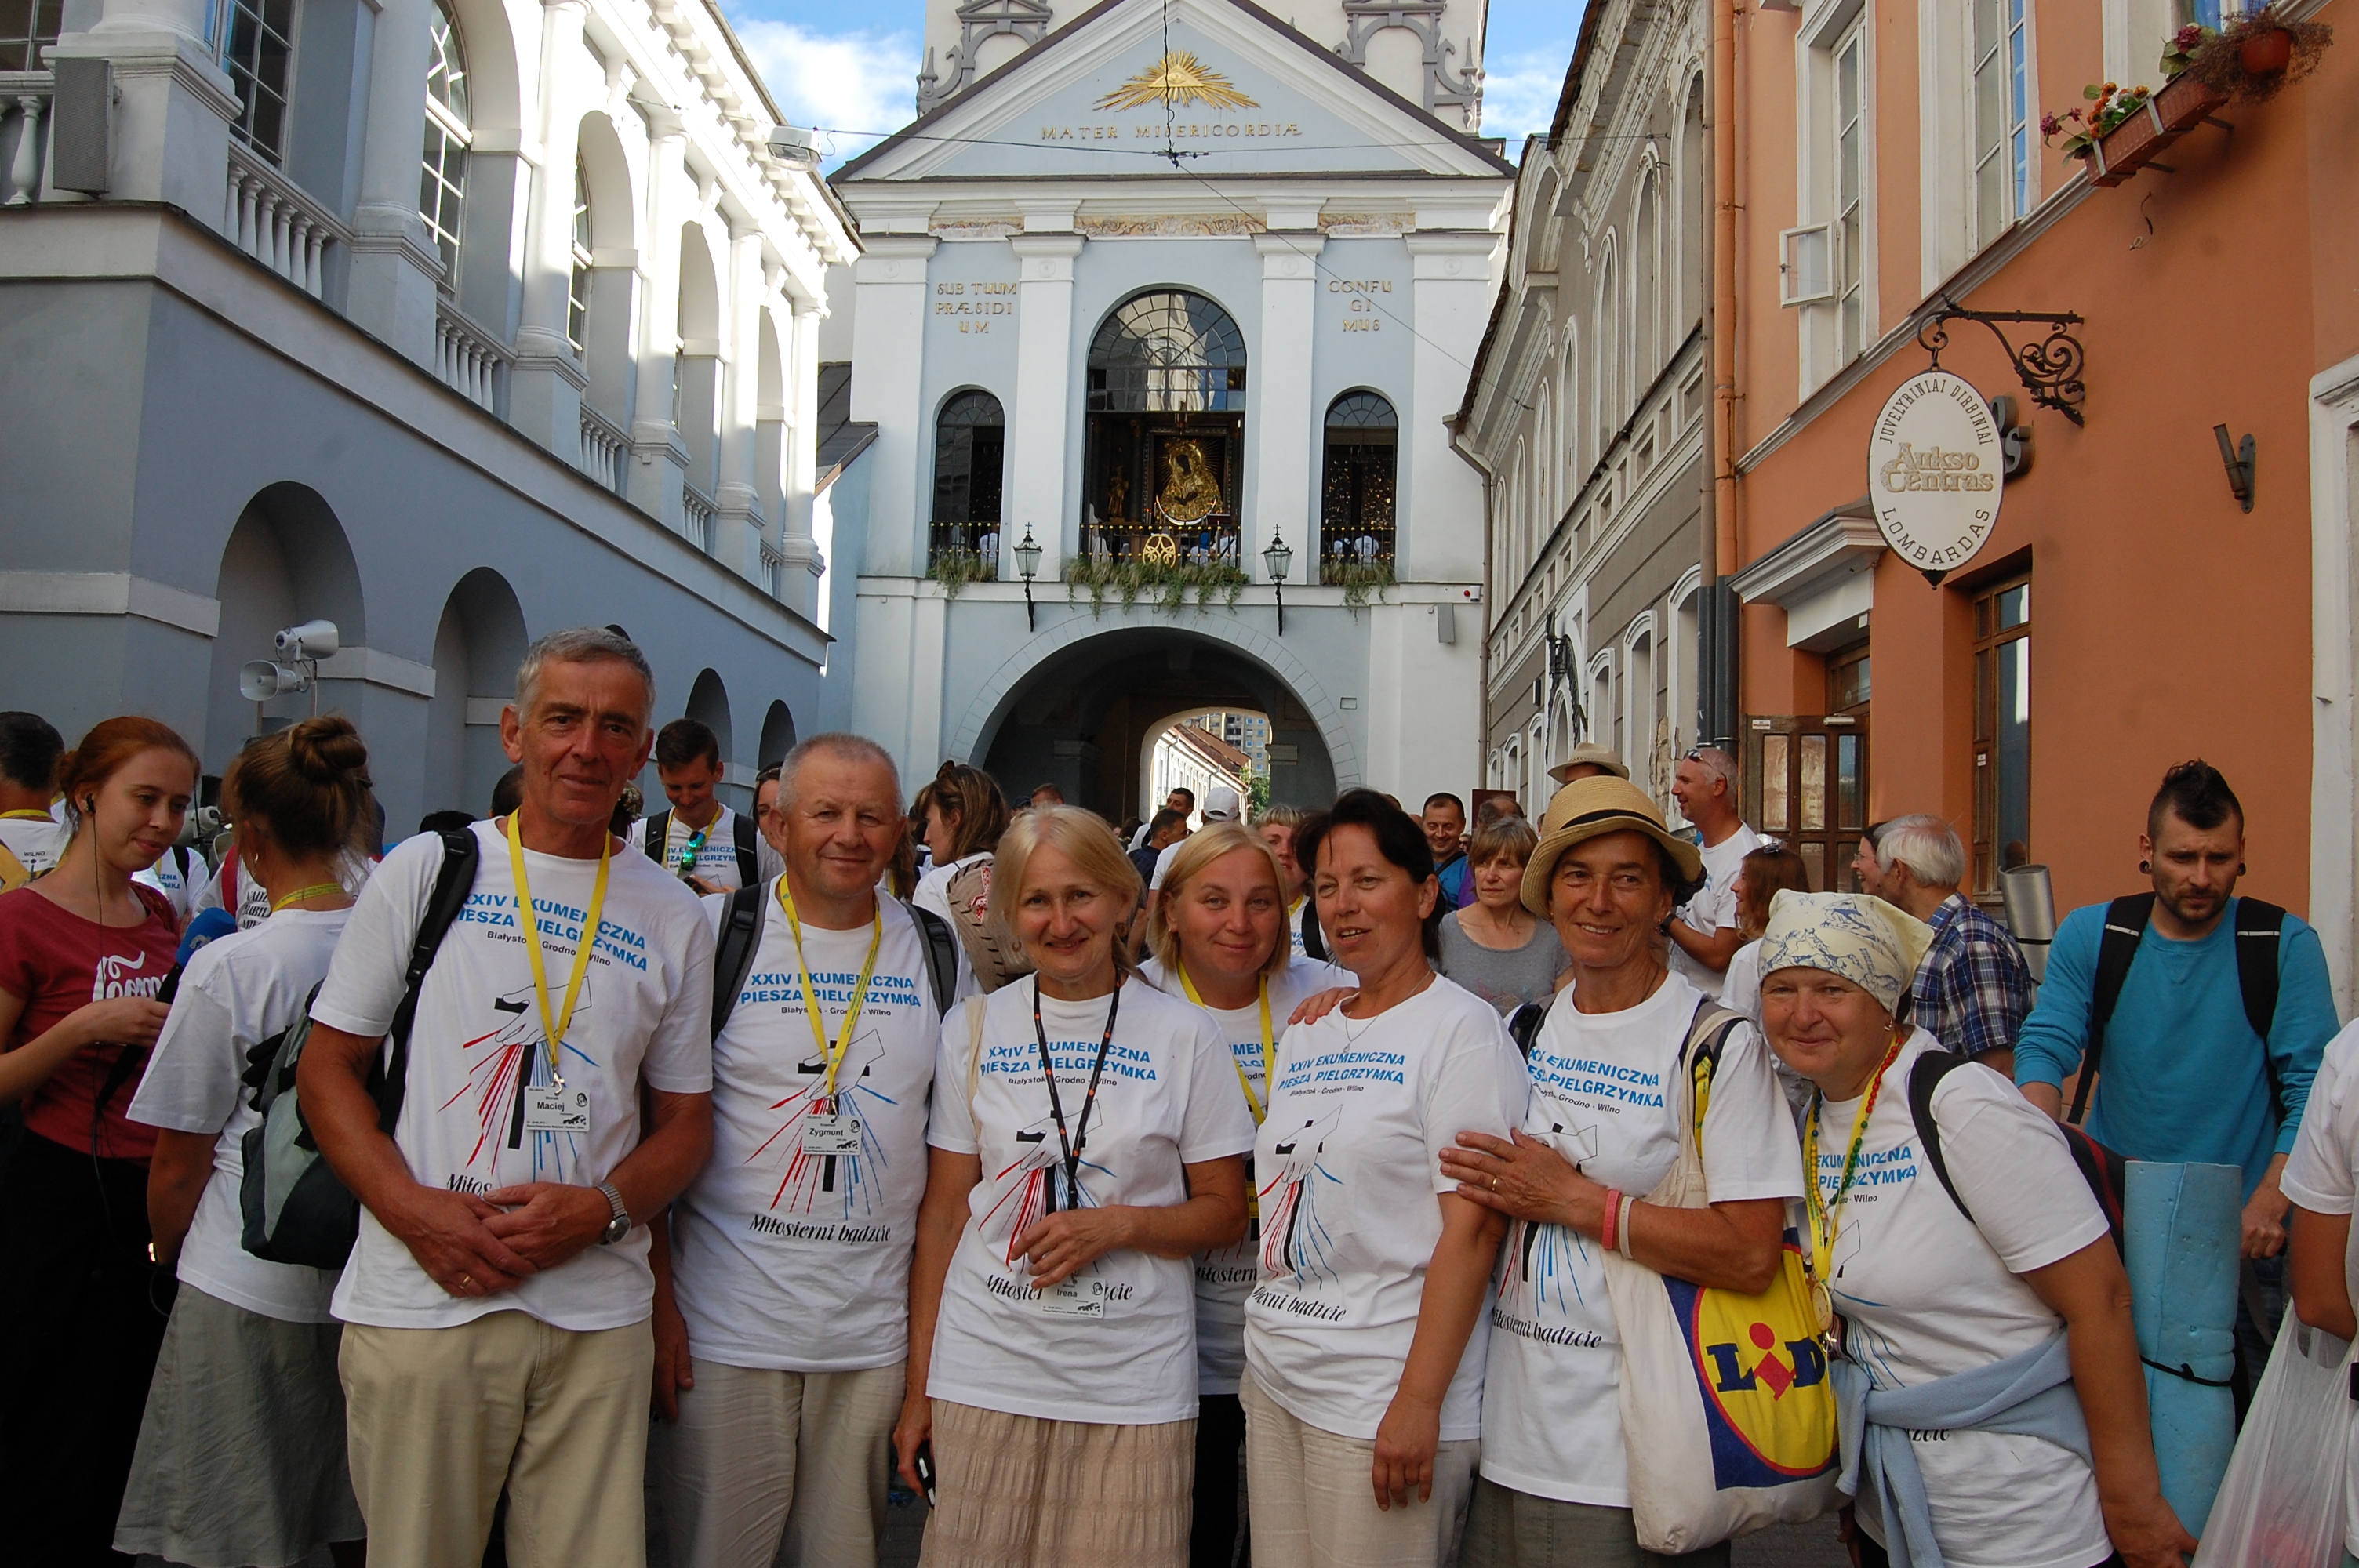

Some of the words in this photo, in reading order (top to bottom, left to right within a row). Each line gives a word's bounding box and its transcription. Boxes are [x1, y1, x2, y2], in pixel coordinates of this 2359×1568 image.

[1041, 126, 1118, 140] MATER
[937, 283, 964, 296] SUB
[971, 282, 1017, 296] TUUM
[1328, 281, 1392, 293] CONFU
[1350, 299, 1372, 312] GI
[1343, 319, 1380, 332] MUS
[1880, 379, 1946, 445] JUVELYRINIAI
[1950, 384, 1994, 445] DIRBINIAI
[1891, 442, 1979, 471] Aukso
[1880, 459, 1994, 493] Centras
[1882, 507, 1990, 564] LOMBARDAS
[458, 908, 514, 927] IESZA
[535, 918, 647, 971] IELGZYMKA
[487, 931, 527, 944] Białysto
[542, 941, 576, 956] Grodno
[751, 973, 792, 986] XXIV
[741, 989, 804, 1004] PIESZA
[781, 1007, 822, 1015] Białysk
[868, 1008, 892, 1017] Wilno
[988, 1045, 1024, 1058] XXIV
[1027, 1041, 1151, 1063] EUMENCZNA
[980, 1061, 1030, 1076] PIESZA
[1288, 1058, 1315, 1073] XXIV
[1315, 1052, 1405, 1065] EKUMENICZNA
[1546, 1054, 1659, 1087] EKUMENICZNA
[1055, 1076, 1085, 1084] Grodno
[1277, 1073, 1311, 1091] PIESZA
[1314, 1069, 1404, 1085] PIELGRZYMKA
[1547, 1073, 1664, 1109] PIELGRZYMKA
[536, 1101, 565, 1112] Maciej
[1558, 1094, 1590, 1109] Grodno
[1598, 1102, 1621, 1115] Wilno
[809, 1127, 844, 1138] Zygmunt
[1816, 1145, 1913, 1169] EKUMNICZNA
[1853, 1194, 1878, 1203] Wilno
[748, 1214, 836, 1241] Miłosierni
[1194, 1266, 1257, 1283] iłosiern
[1056, 1288, 1078, 1298] Irena
